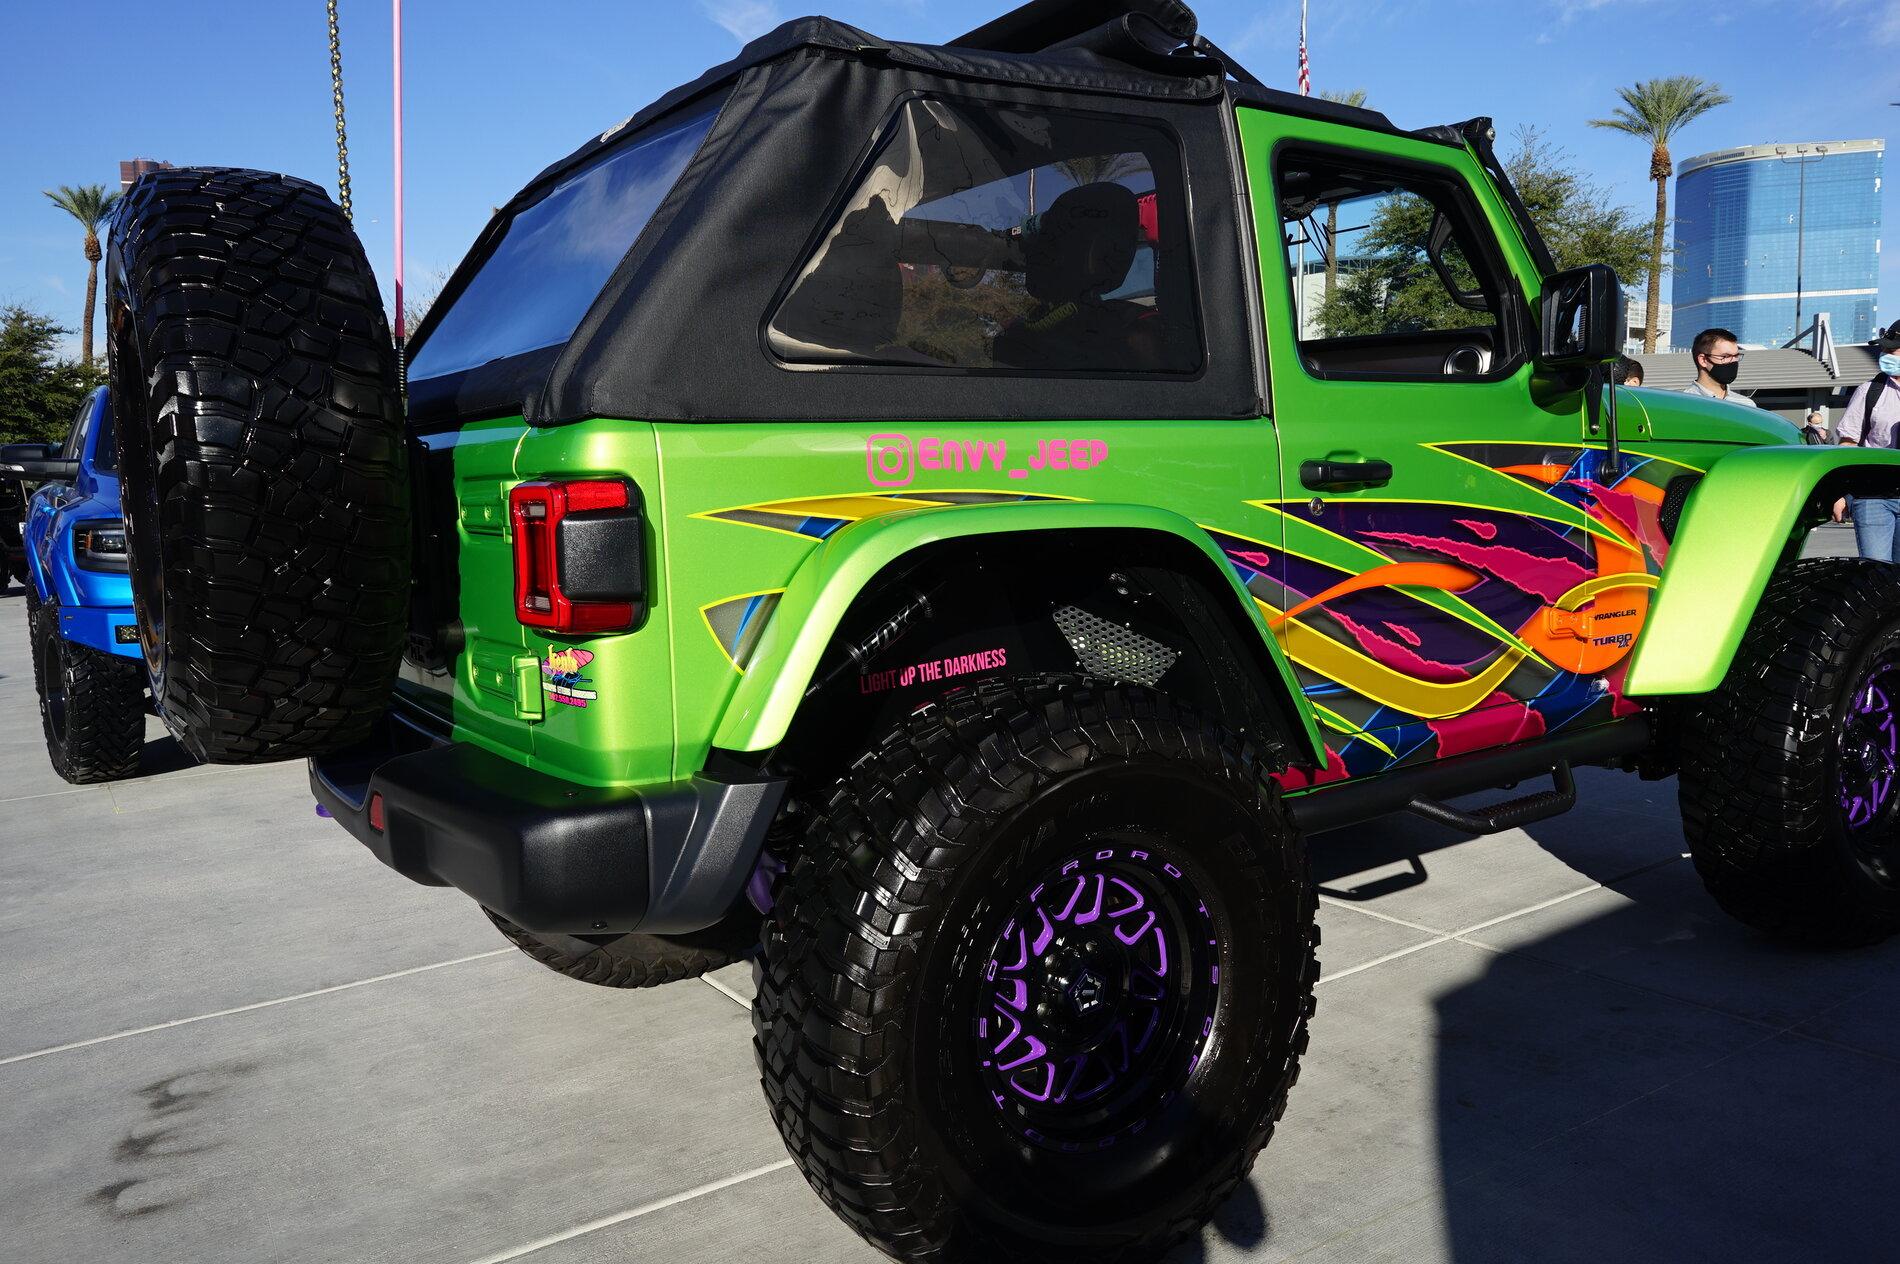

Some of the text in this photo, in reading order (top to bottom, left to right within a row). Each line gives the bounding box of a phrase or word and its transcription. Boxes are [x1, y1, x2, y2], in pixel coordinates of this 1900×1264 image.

[1594, 609, 1636, 620] WRANGLER
[1593, 633, 1632, 646] TURBO
[860, 648, 1006, 694] LIGHT UP THE DARKNESS
